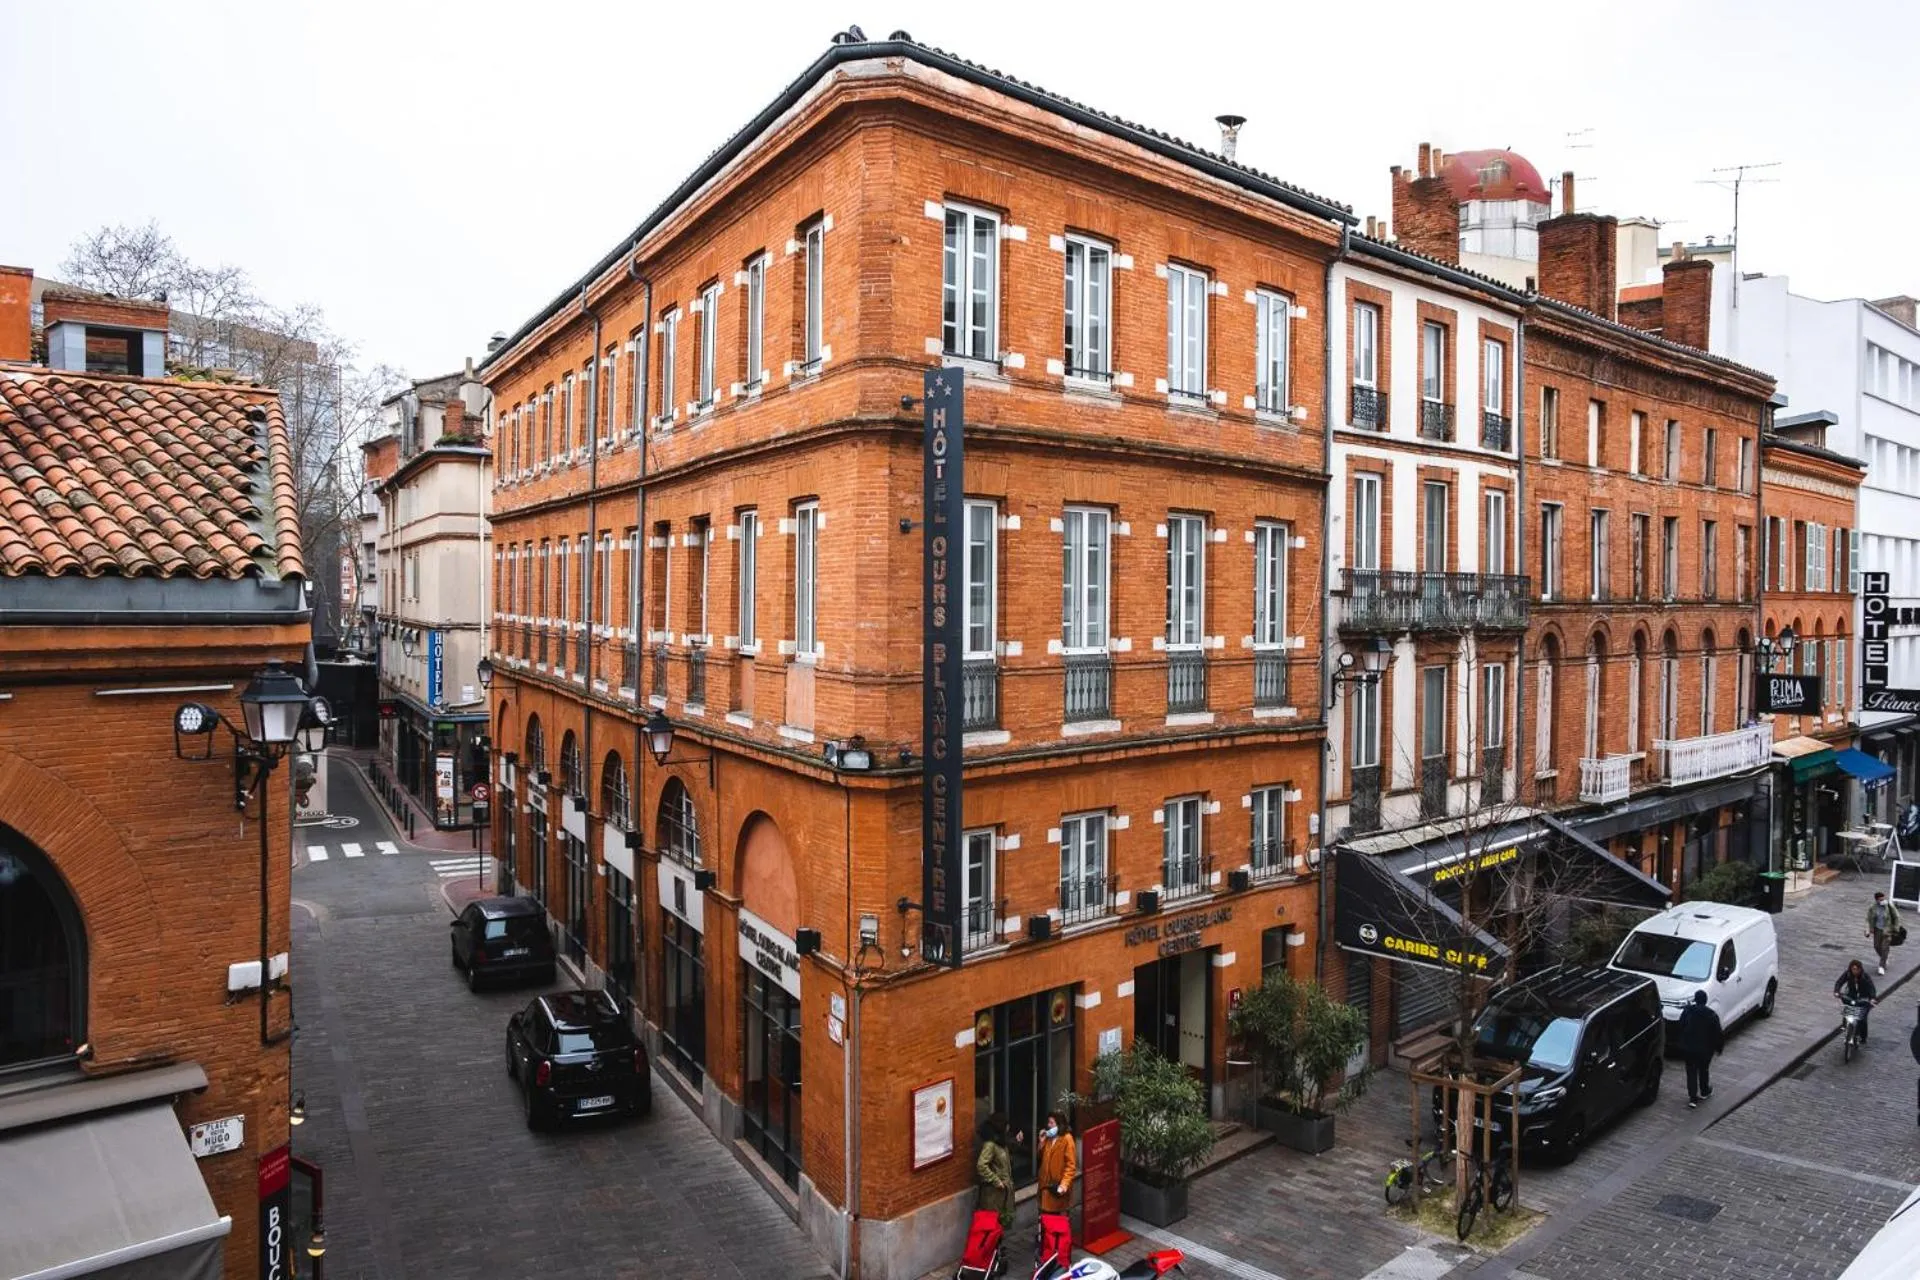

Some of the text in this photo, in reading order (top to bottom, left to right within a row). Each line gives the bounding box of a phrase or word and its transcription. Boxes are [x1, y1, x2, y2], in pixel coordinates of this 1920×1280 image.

[1865, 574, 1886, 684] HOTEL
[434, 632, 443, 695] HOTEL
[931, 407, 948, 912] HÔTEL OURS BLANC CENTRE
[1384, 936, 1439, 958] CARIBE
[204, 1133, 230, 1146] HUGO
[206, 1120, 229, 1131] PLACE
